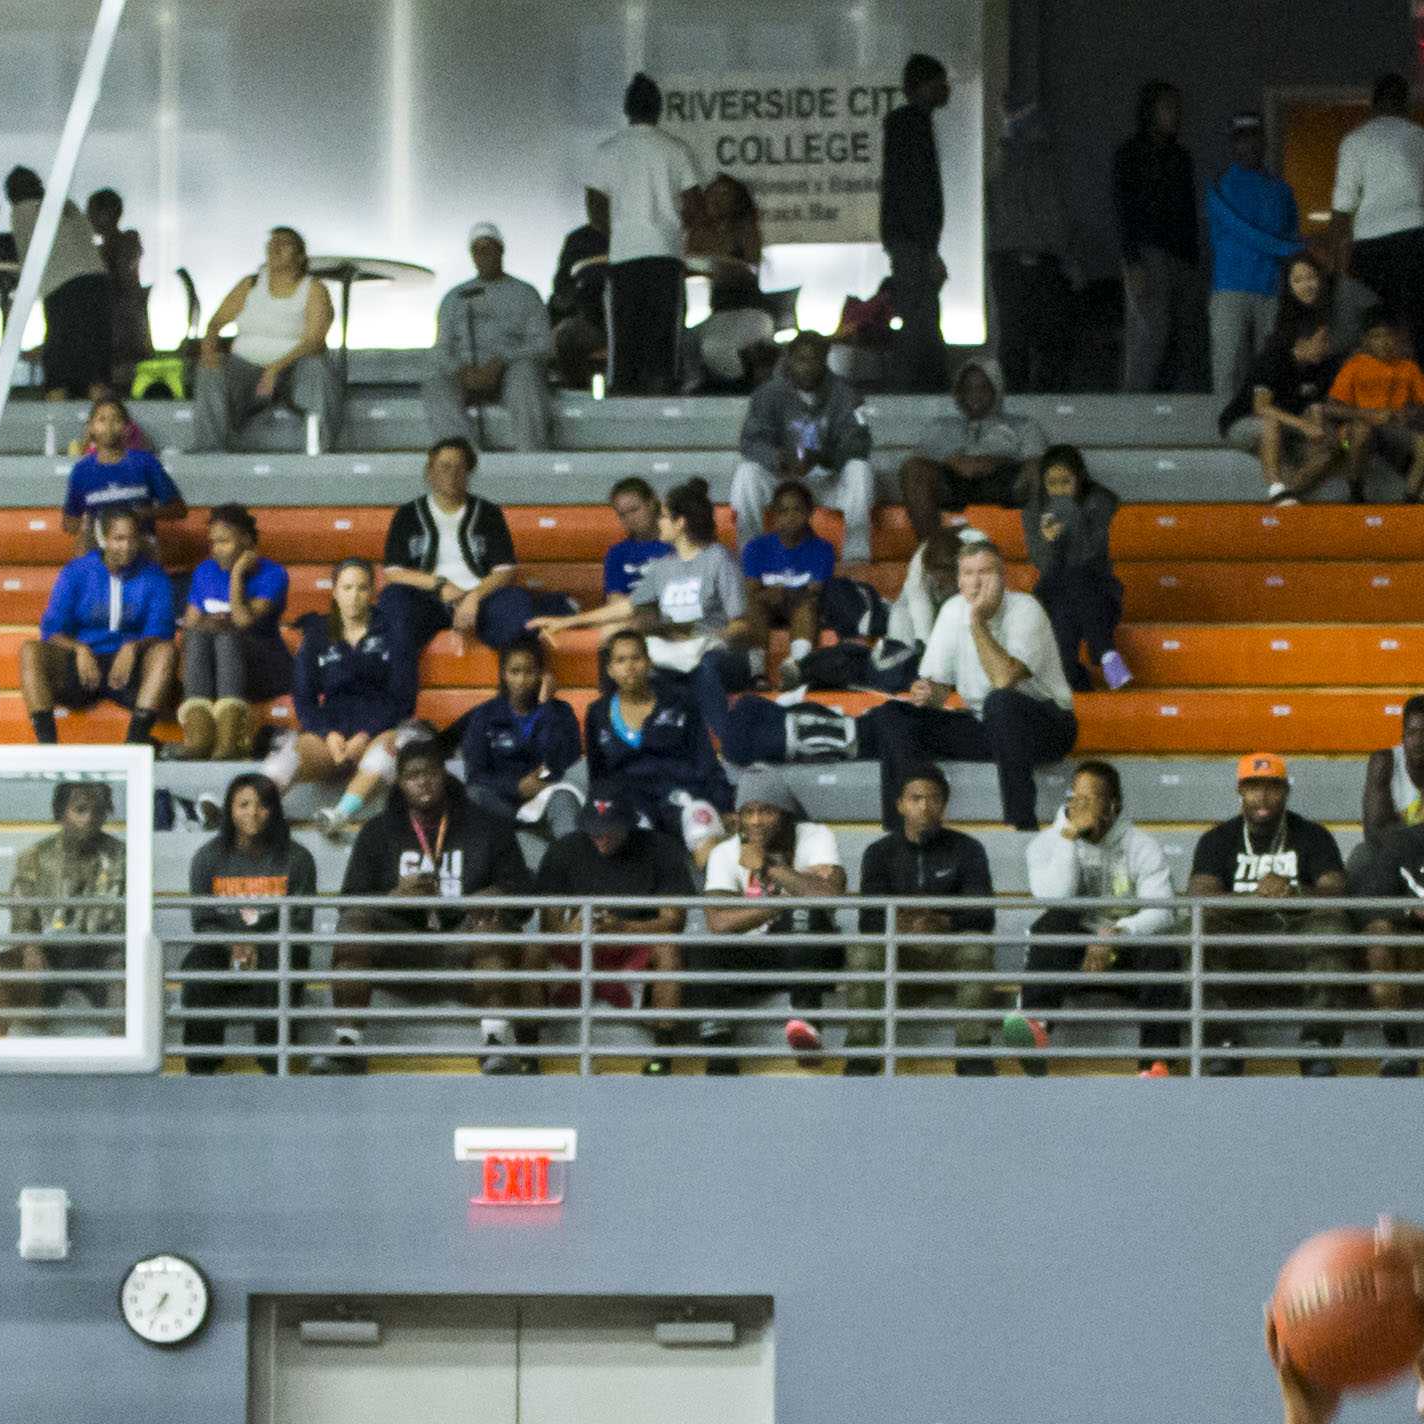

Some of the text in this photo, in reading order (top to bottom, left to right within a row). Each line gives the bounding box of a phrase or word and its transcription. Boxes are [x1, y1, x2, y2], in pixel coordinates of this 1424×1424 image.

[665, 85, 906, 121] RIVERSIDE CIT
[716, 131, 871, 166] COLLEGE
[483, 1155, 551, 1201] EXIT
